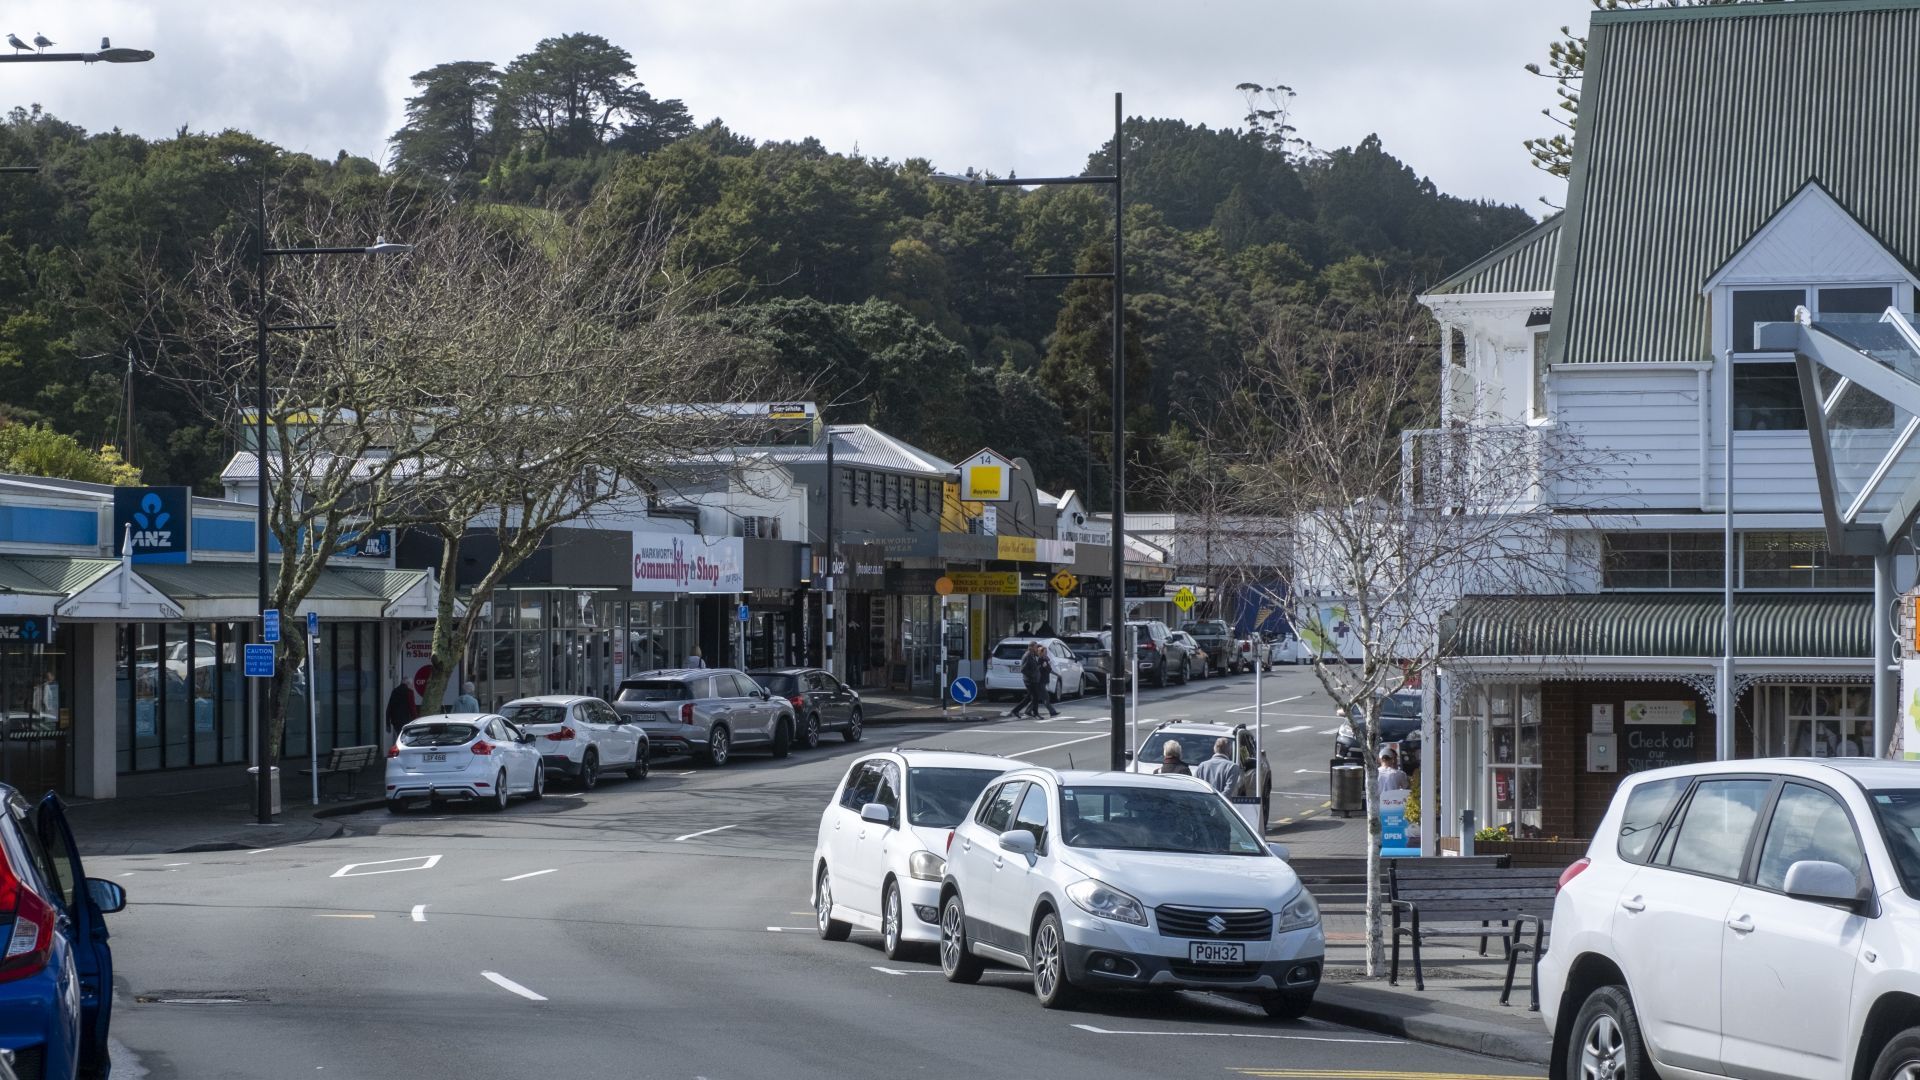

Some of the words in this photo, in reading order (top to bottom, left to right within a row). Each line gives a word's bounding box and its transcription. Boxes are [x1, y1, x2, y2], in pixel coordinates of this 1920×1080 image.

[980, 456, 991, 465] 14
[131, 531, 171, 547] ANZ
[641, 547, 673, 559] WARKWORTH
[634, 551, 689, 586] Community
[697, 555, 719, 587] Shop
[0, 626, 20, 639] NZ
[1628, 730, 1669, 749] Check
[1672, 731, 1696, 749] out
[1648, 750, 1666, 759] our
[1196, 945, 1238, 961] PQH32
